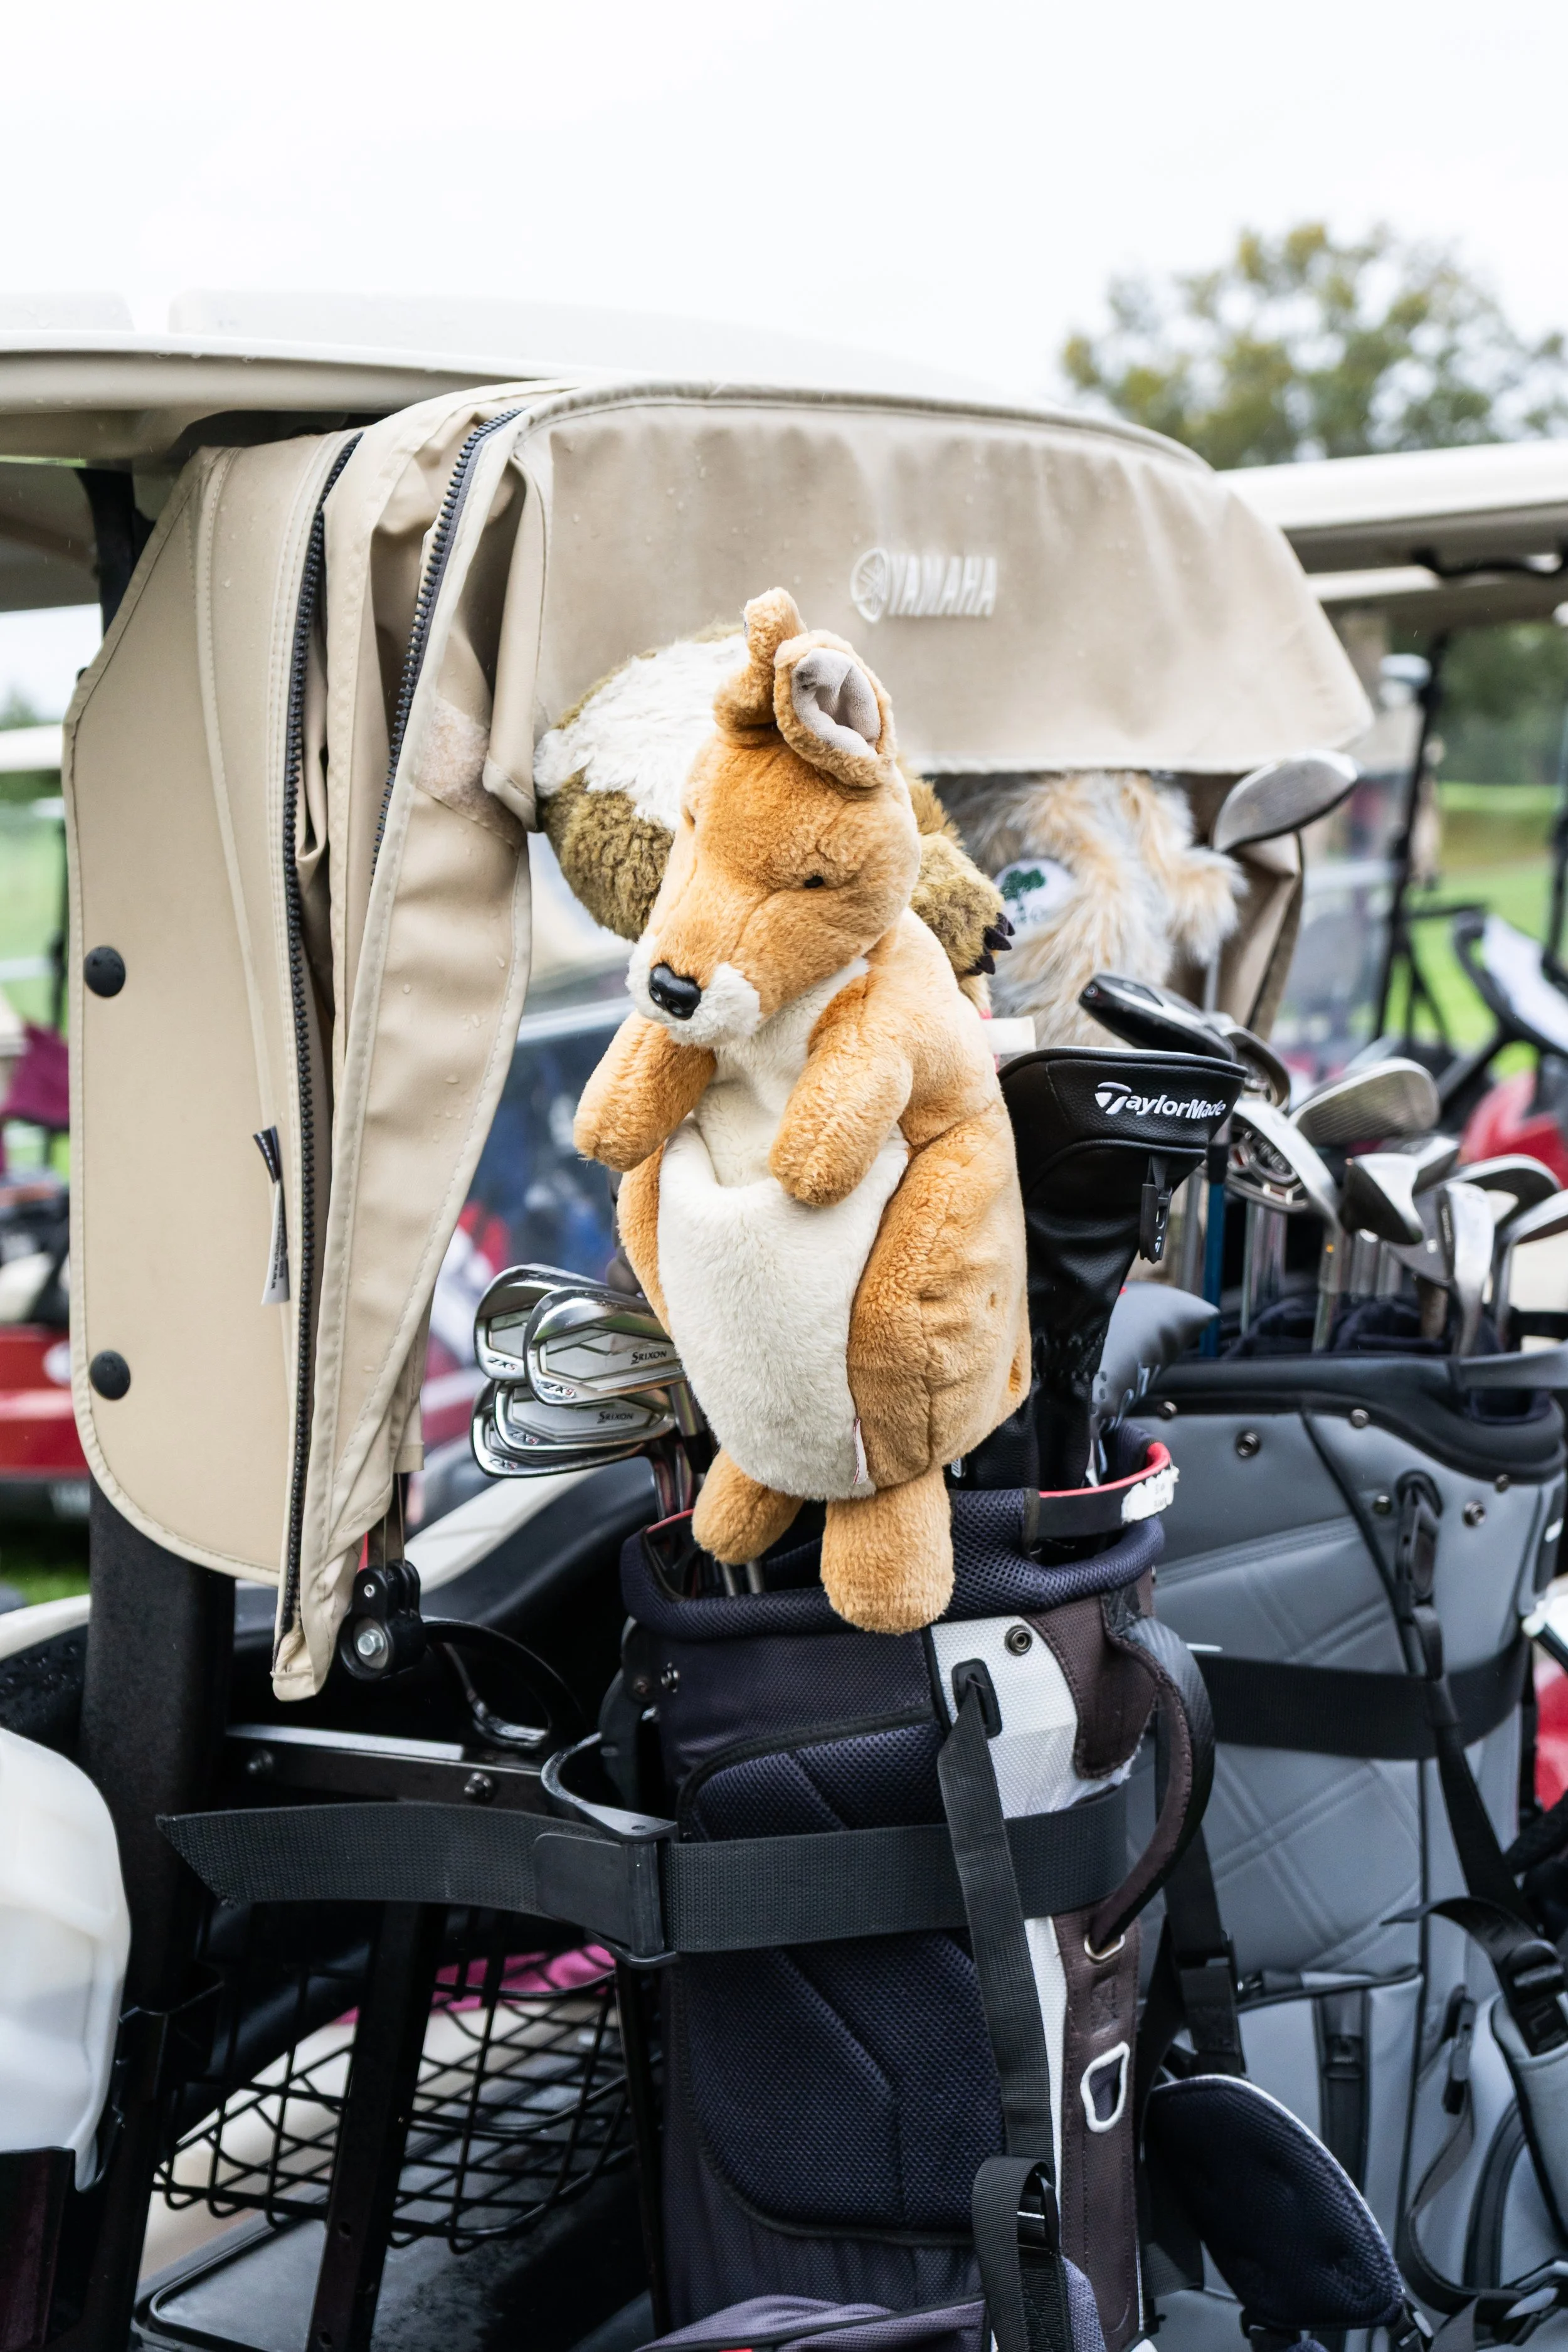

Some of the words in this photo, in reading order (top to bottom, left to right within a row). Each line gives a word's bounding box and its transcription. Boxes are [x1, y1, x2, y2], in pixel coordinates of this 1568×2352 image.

[1094, 1081, 1226, 1120] TaylorMade
[631, 1350, 667, 1365] SRIXON
[597, 1411, 633, 1424] SRIXON
